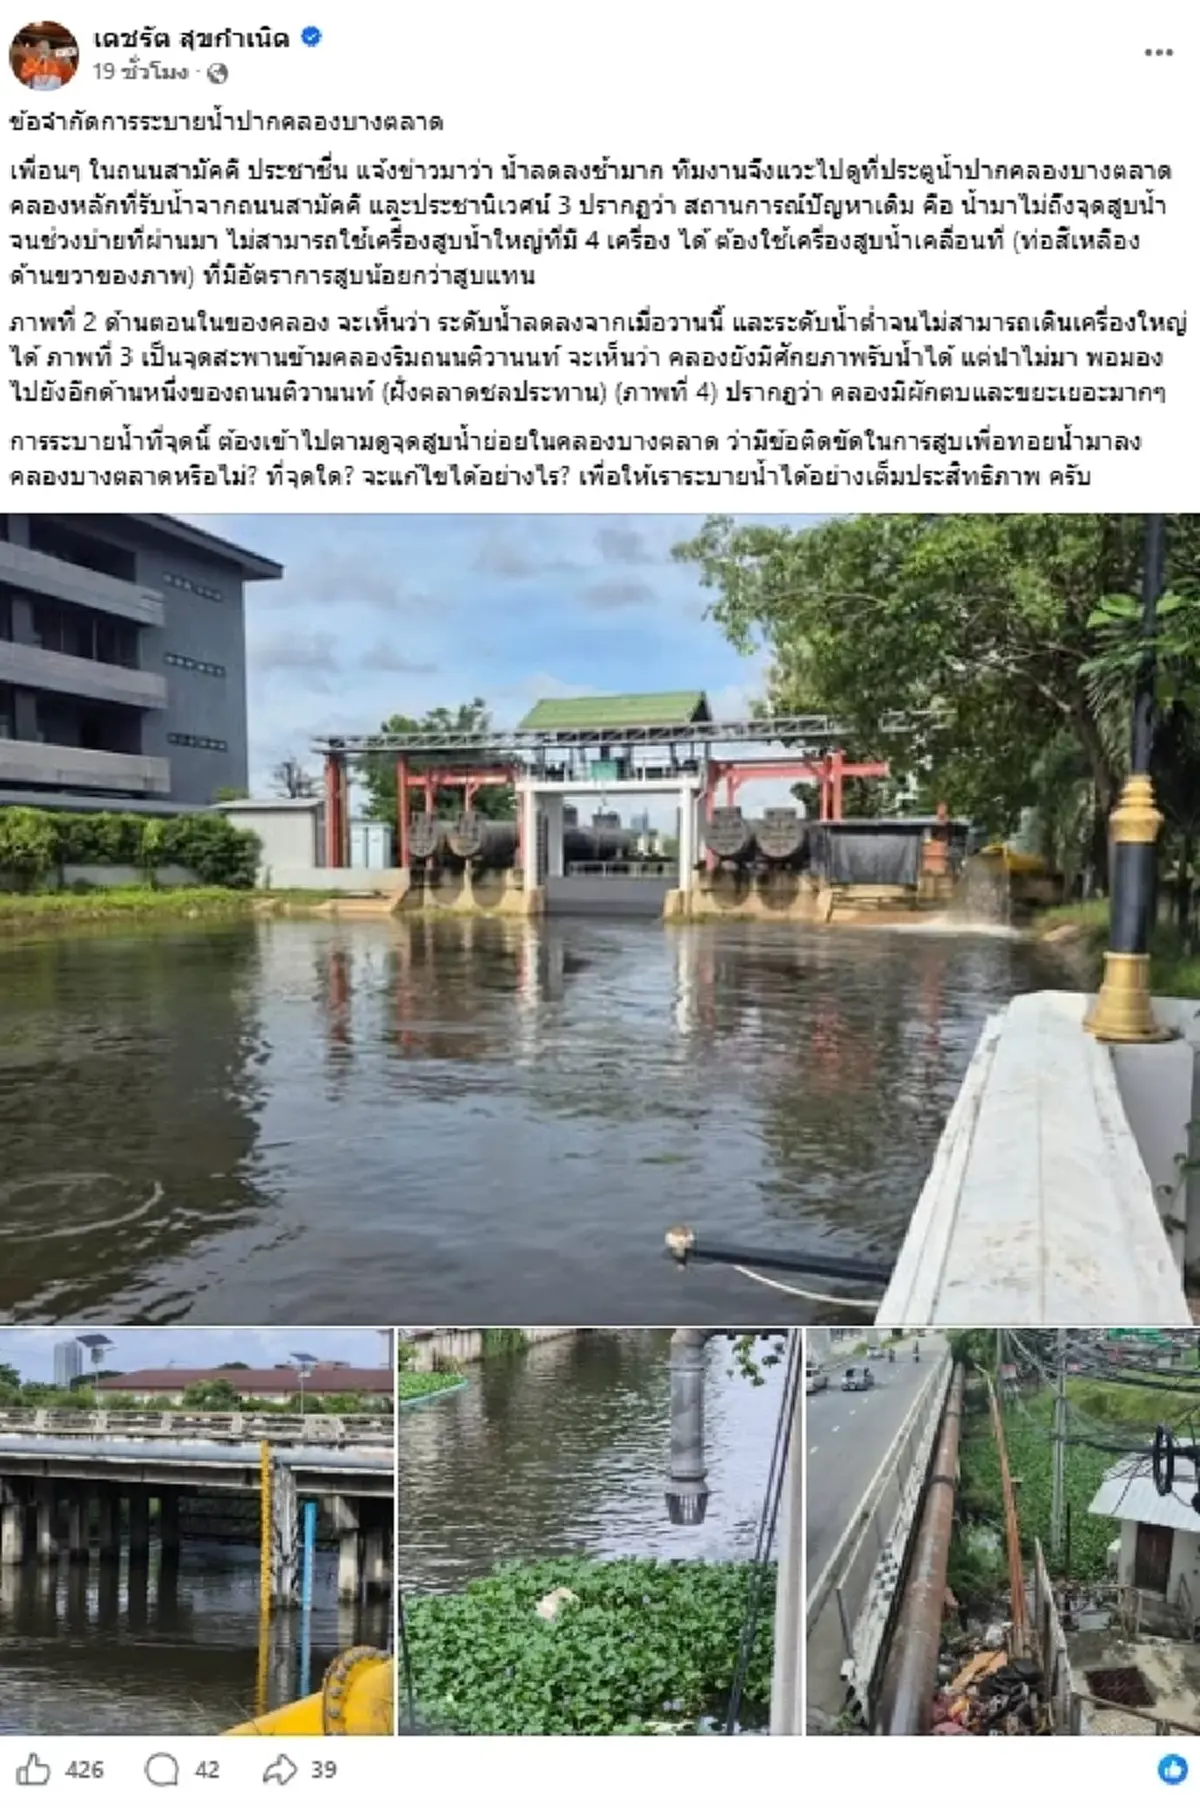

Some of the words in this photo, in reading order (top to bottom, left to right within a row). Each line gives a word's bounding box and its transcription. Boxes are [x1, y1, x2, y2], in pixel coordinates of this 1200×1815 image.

[95, 26, 170, 48] เดชรัต
[180, 26, 289, 51] สุขกำเนิด
[94, 63, 114, 79] 19
[121, 55, 189, 79] ชั่วโมง
[11, 154, 80, 182] เพื่อนๆ
[89, 157, 239, 179] ในถนนสามัคคี
[248, 151, 348, 180] ประชาชื่น
[357, 158, 492, 179] แจ้งข่าวมาว่า
[501, 154, 663, 180] น้ำลดลงช้ามาก
[370, 192, 551, 215] และประชานิเวศน์
[559, 196, 571, 214] 3
[685, 192, 913, 220] สถานการณ์ปัญหาเดิม
[923, 193, 953, 214] คือ
[9, 224, 217, 250] จนช่วงบ่ายที่ผ่านมา
[585, 231, 599, 249] 4
[608, 224, 670, 250] เครื่อง
[678, 228, 711, 250] ได้
[1014, 226, 1139, 254] (ท่อสีเหลือง
[11, 263, 193, 289] ด้านขวาของภาพ)
[9, 305, 75, 331] ภาพที่
[83, 312, 96, 331] 2
[105, 310, 329, 332] ด้านตอนในของคลอง
[338, 305, 430, 331] จะเห็นว่า
[9, 345, 41, 366] ได้
[47, 340, 111, 366] ภาพที่
[120, 347, 133, 366] 3
[568, 340, 659, 367] จะเห็นว่า
[1086, 352, 1163, 366] พอมอง
[383, 375, 606, 405] (ฝั่งตลาดชลประทาน)
[616, 375, 687, 405] (ภาพที่
[696, 382, 717, 405] 4)
[10, 464, 257, 486] คลองบางตลาดหรือไม่?
[266, 459, 354, 489] ที่จุดใด?
[362, 464, 570, 486] จะแก้ไขได้อย่างไร?
[1050, 464, 1090, 485] ครับ
[65, 1761, 103, 1778] 426
[195, 1761, 219, 1778] 42
[312, 1761, 336, 1778] 39
